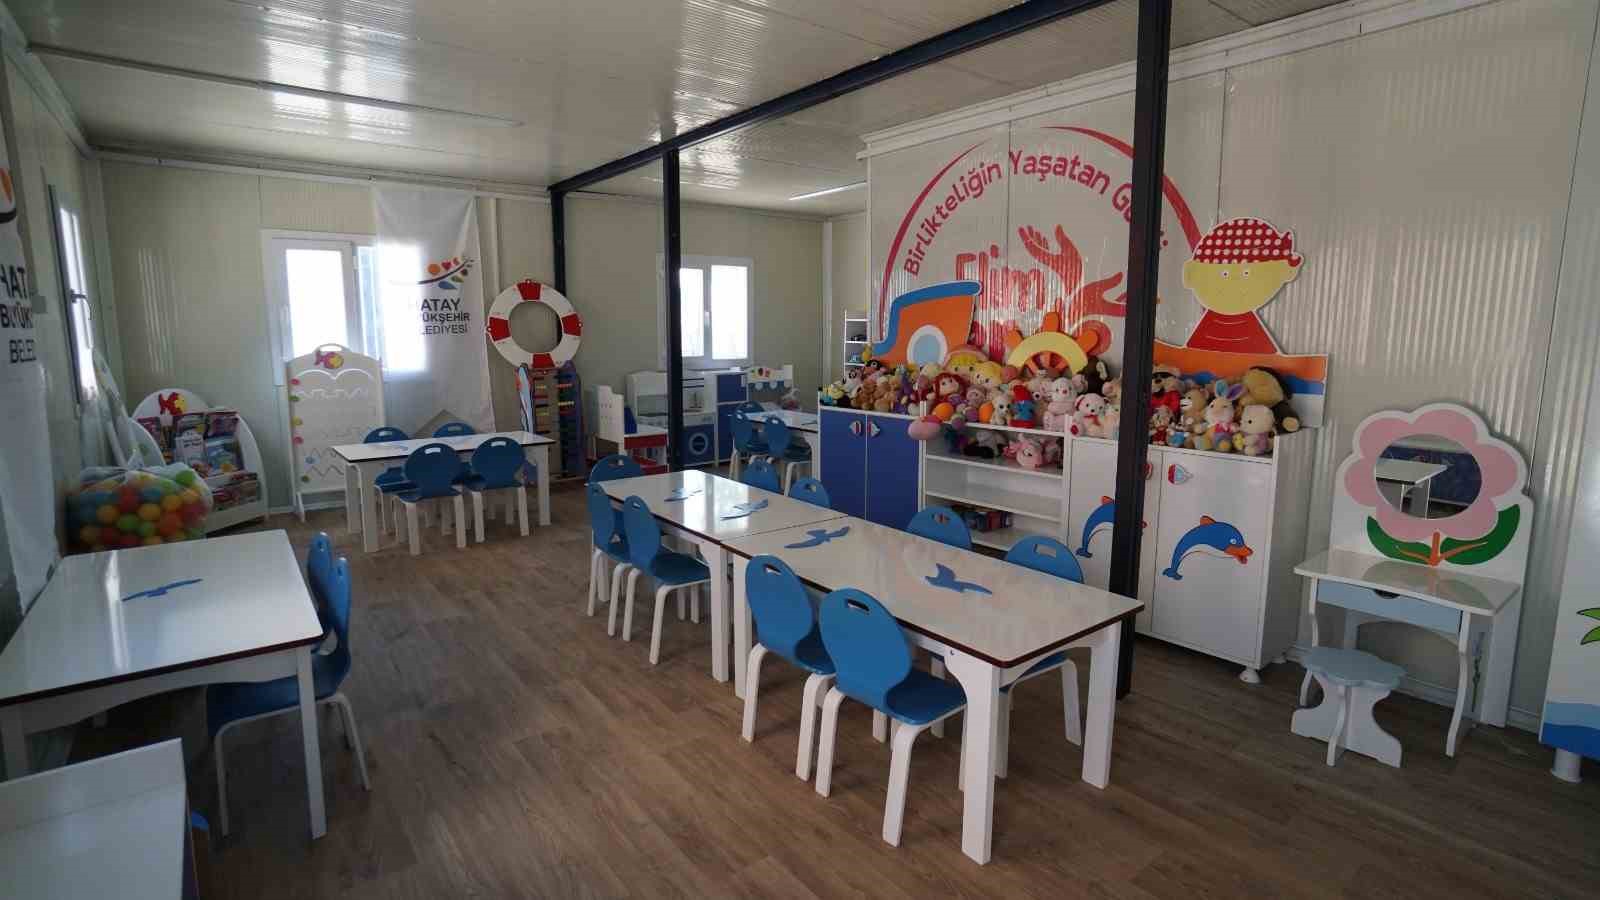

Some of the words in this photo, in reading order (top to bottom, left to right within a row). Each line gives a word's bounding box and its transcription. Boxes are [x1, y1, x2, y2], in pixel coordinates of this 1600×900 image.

[904, 162, 1002, 276] Birlikteliğin
[1008, 150, 1110, 194] Yaşatan
[420, 297, 461, 312] ATAY
[422, 312, 470, 324] ÜKŞEHİR
